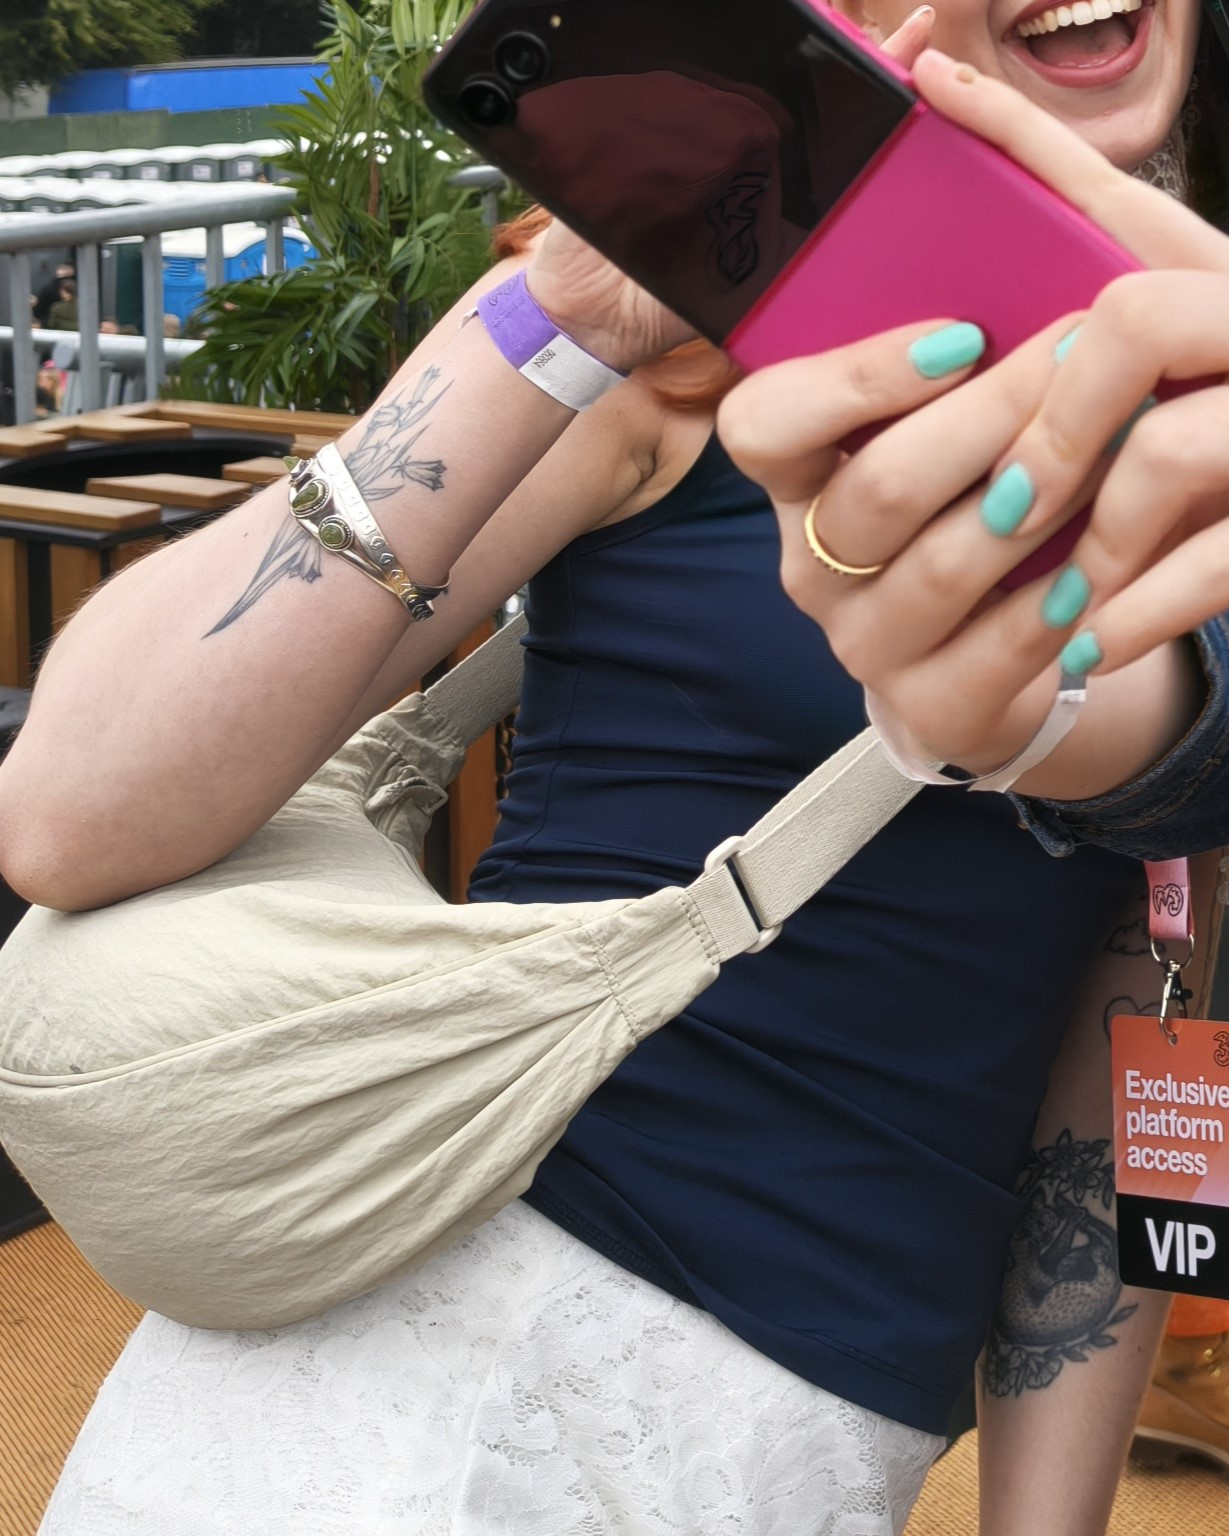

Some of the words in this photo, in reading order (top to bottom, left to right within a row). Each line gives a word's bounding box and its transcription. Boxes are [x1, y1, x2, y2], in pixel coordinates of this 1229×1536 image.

[1126, 1104, 1224, 1143] platform
[1127, 1145, 1208, 1176] access
[1145, 1217, 1216, 1277] VIP
